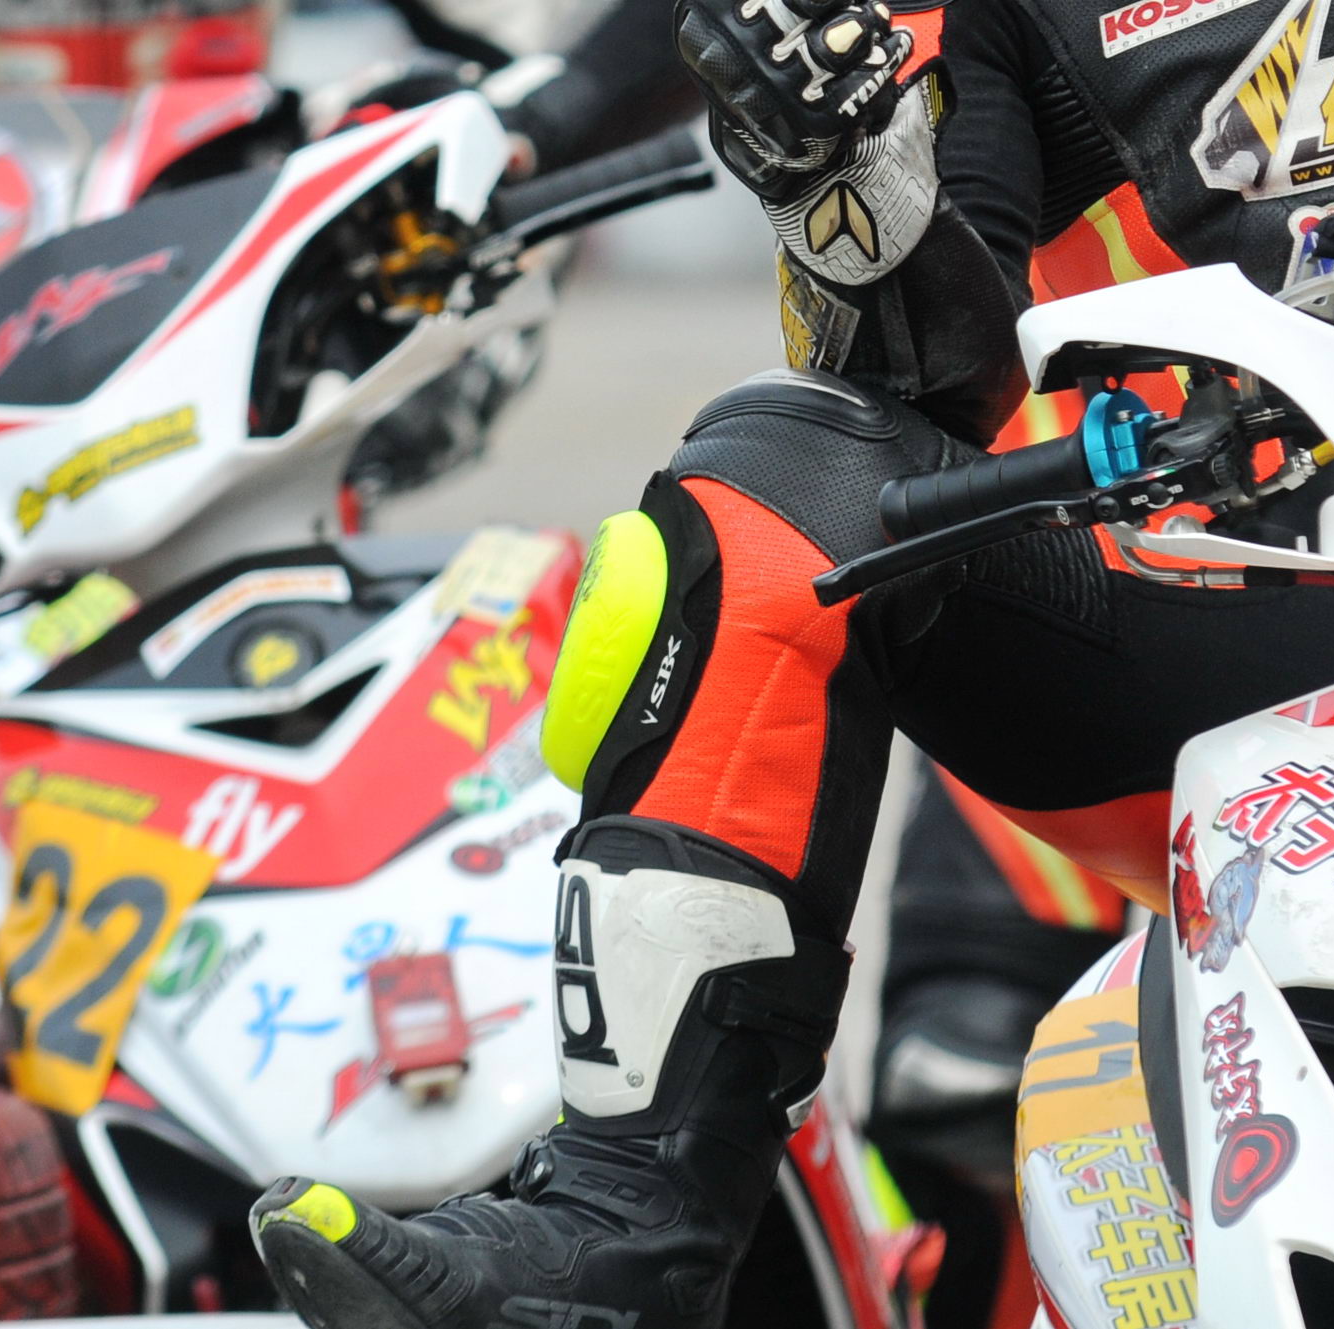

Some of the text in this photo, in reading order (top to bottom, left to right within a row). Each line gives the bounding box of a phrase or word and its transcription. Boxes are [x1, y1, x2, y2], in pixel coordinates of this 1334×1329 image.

[1167, 12, 1204, 30] The
[180, 774, 305, 883] fly
[5, 842, 169, 1067] 22
